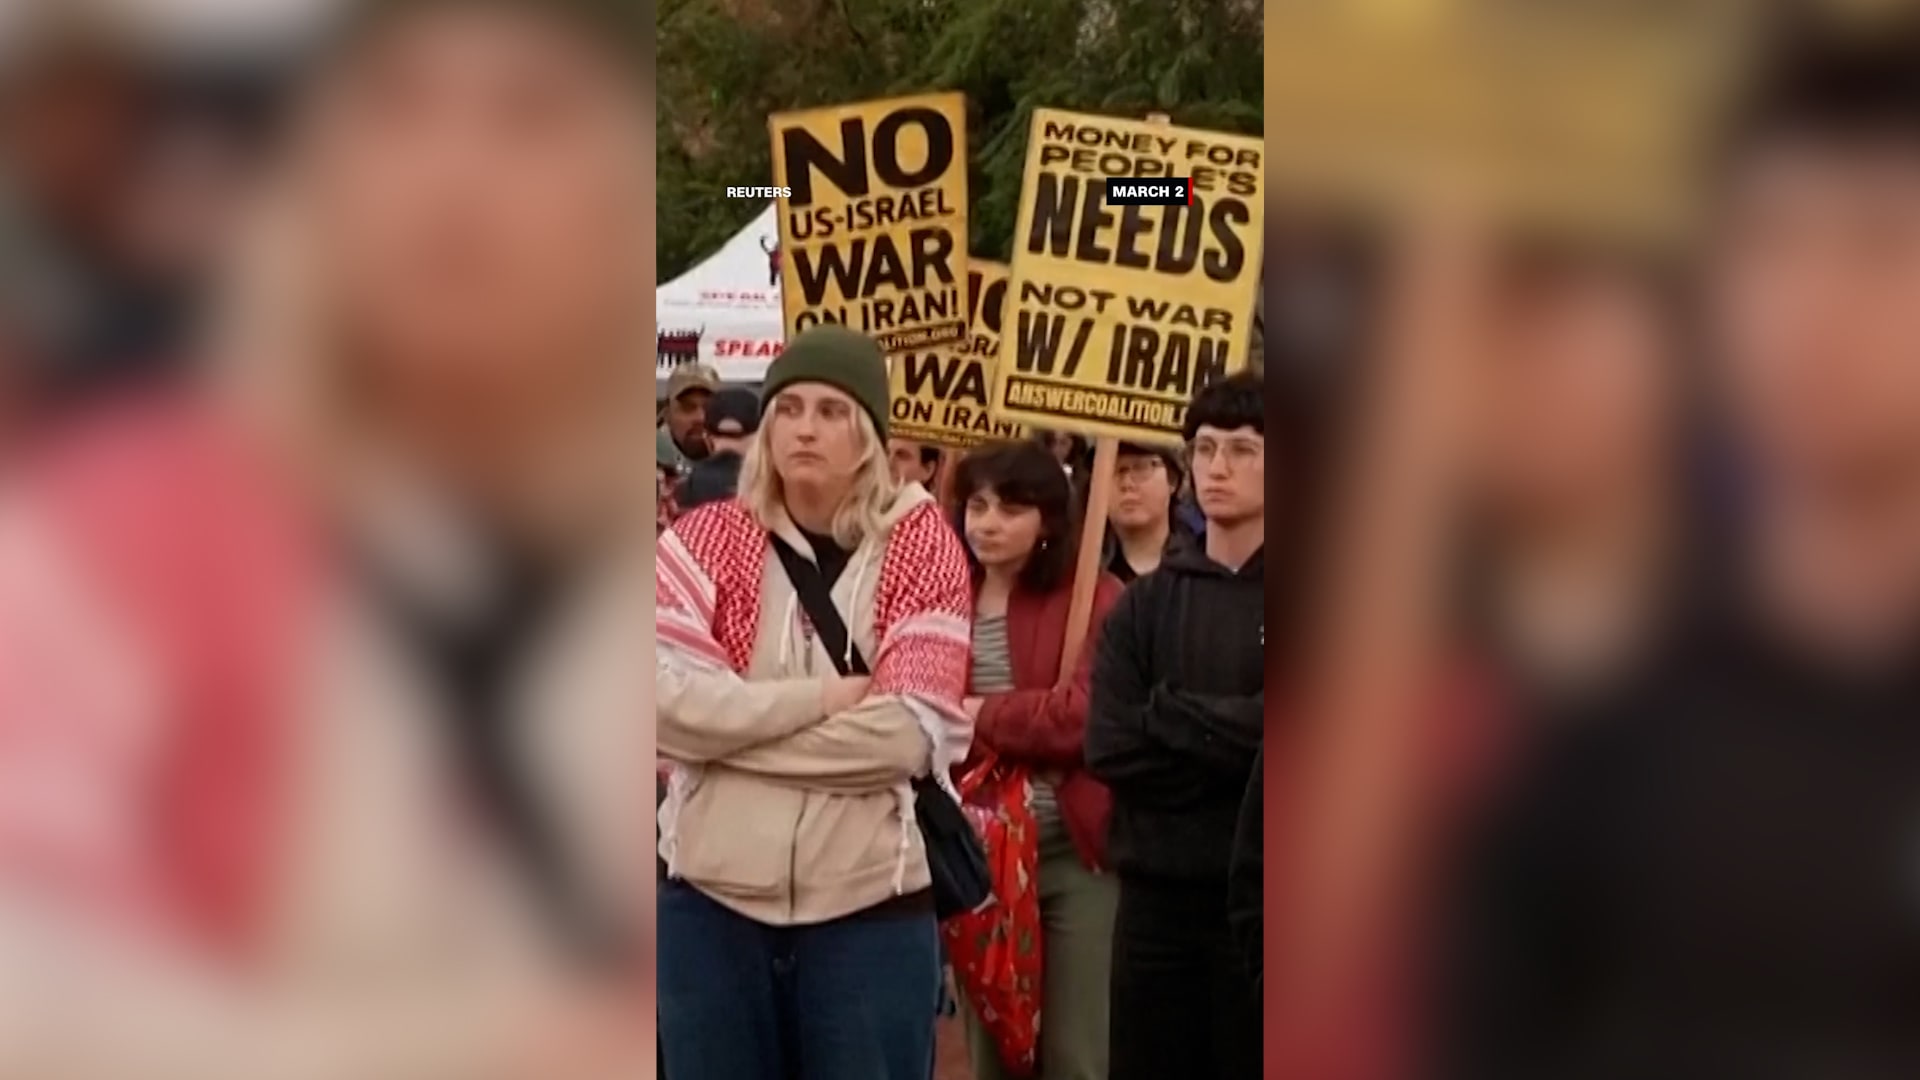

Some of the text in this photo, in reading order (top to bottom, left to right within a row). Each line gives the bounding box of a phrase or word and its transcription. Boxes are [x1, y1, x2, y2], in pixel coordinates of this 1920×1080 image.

[782, 107, 954, 207] NO
[1044, 121, 1260, 169] MONEY FOR
[789, 188, 955, 240] US-ISRAEL
[1028, 172, 1249, 283] NEEDS
[791, 225, 955, 306] WAR
[862, 289, 957, 331] IRAN!
[1020, 280, 1115, 315] NOT
[1127, 296, 1233, 334] WAR
[1016, 310, 1230, 395] W/ IRAN
[905, 353, 988, 407] WA
[1008, 380, 1188, 427] ANSWERCOALITION.
[892, 397, 933, 423] ON
